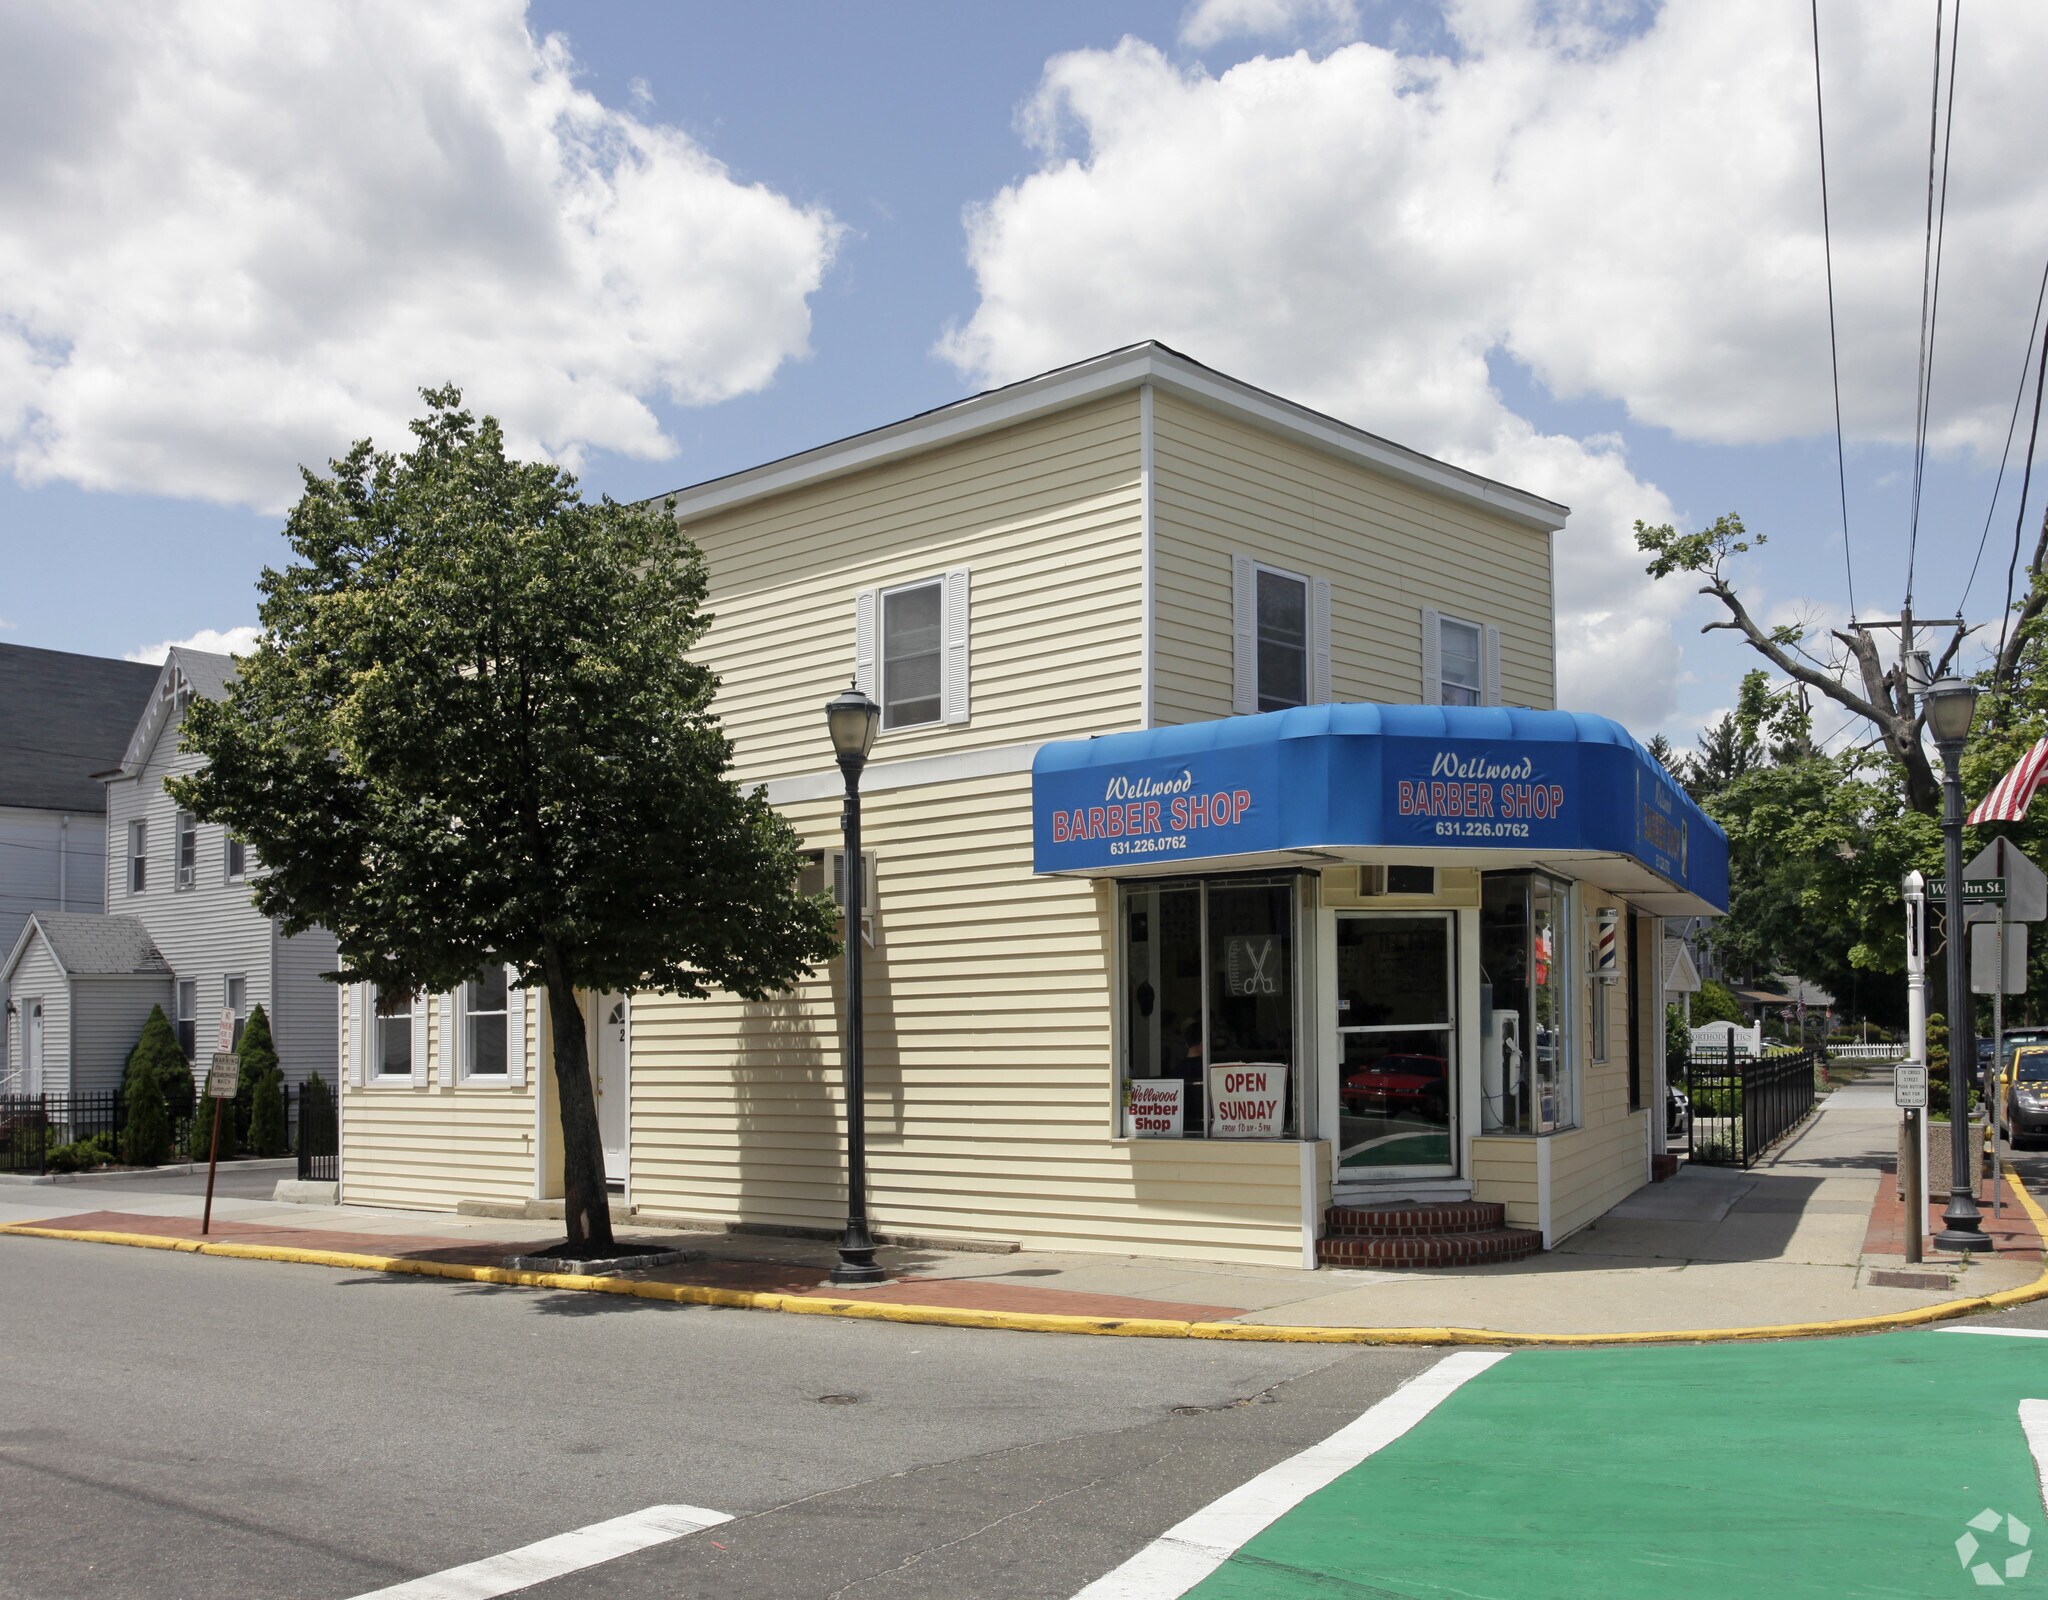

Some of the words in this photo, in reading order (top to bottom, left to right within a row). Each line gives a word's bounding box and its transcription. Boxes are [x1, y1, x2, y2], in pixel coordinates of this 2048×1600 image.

[1430, 752, 1532, 779] Wellwood
[1105, 770, 1192, 801] Wellwood
[1398, 780, 1494, 817] BARBER
[1501, 783, 1564, 819] SHOP
[1052, 800, 1161, 843] BARBER
[1170, 789, 1251, 831] SHOP
[1435, 822, 1529, 837] 631.226.0762
[1110, 835, 1187, 855] 631.226.0762
[1986, 881, 2004, 894] St.
[214, 1056, 239, 1065] WARNING
[1225, 1073, 1267, 1093] OPEN
[1131, 1085, 1179, 1102] Wellwood
[1128, 1103, 1178, 1116] Barber
[1219, 1100, 1277, 1120] SUNDAY
[1135, 1117, 1171, 1132] Shop
[1221, 1124, 1236, 1132] FROM
